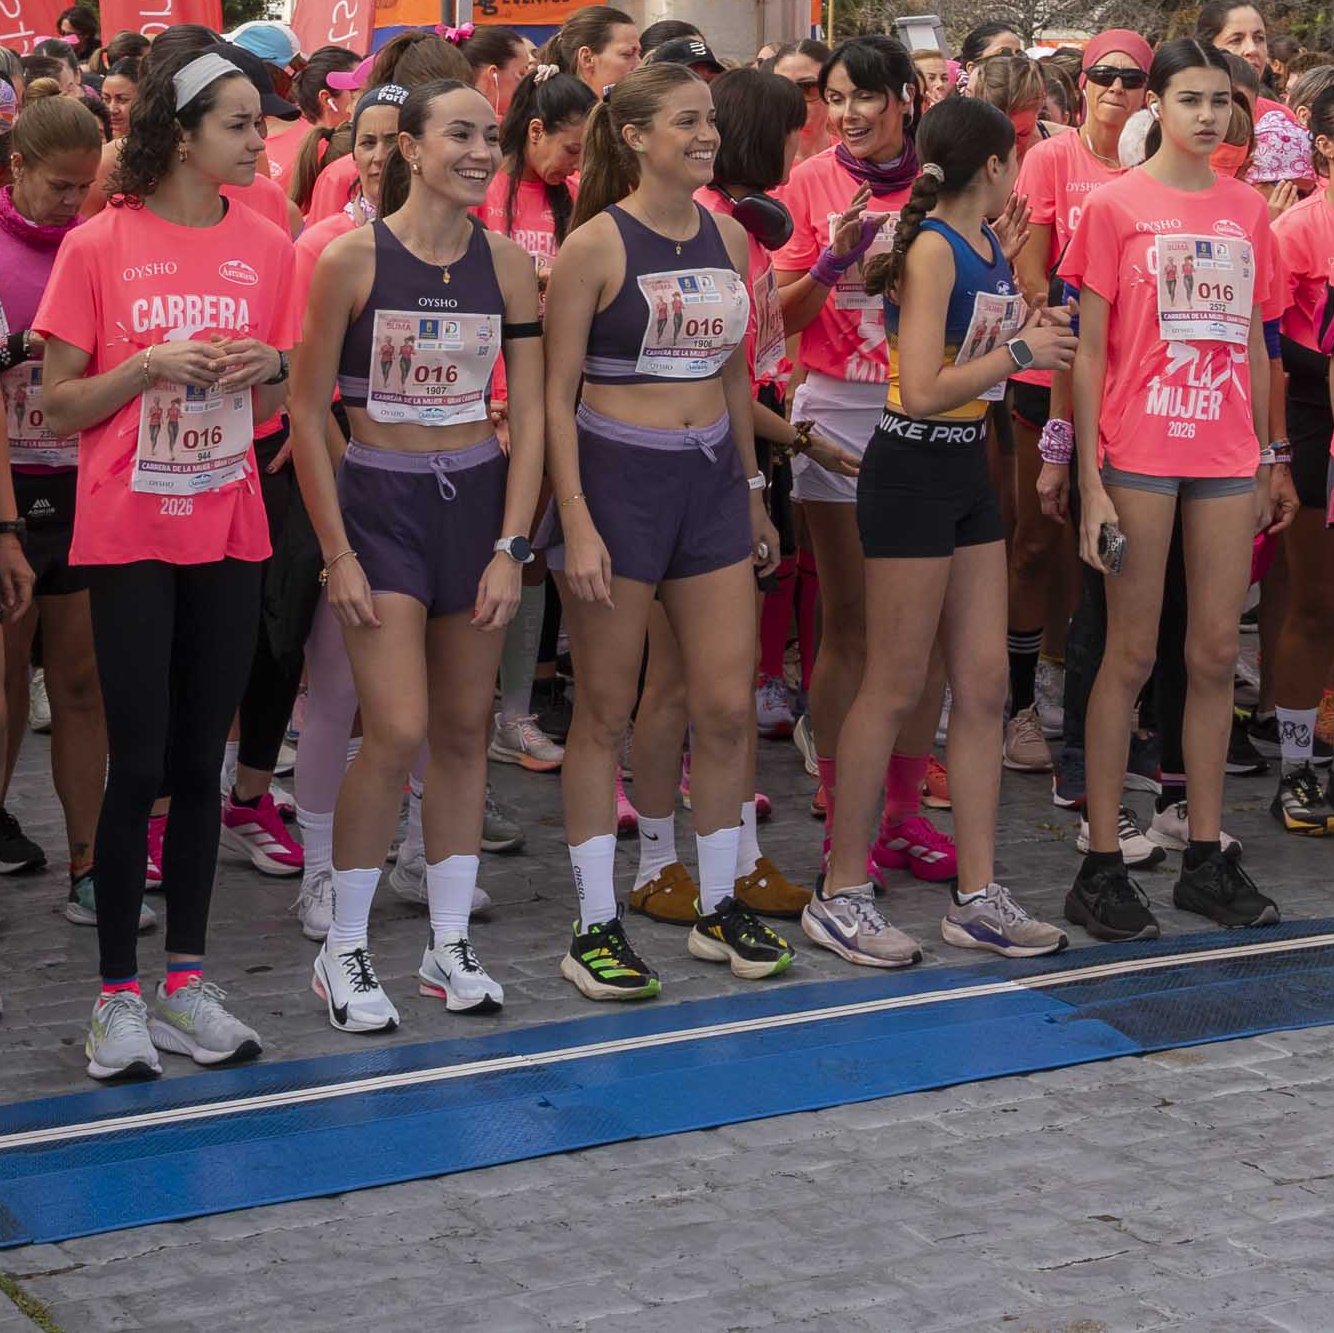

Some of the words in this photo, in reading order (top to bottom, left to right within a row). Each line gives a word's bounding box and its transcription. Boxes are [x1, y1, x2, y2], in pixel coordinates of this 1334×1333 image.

[1136, 219, 1181, 232] OYSHO
[123, 261, 177, 281] OYSHO
[1198, 283, 1234, 301] 016
[419, 298, 457, 307] OYSHO
[133, 295, 249, 332] CARRERA
[686, 318, 723, 336] 016
[415, 365, 457, 383] 016
[1147, 386, 1223, 420] MUJER
[183, 426, 222, 449] 016
[880, 414, 928, 440] NIKE
[929, 426, 976, 443] PRO
[1168, 421, 1195, 438] 2026
[160, 498, 193, 516] 2026
